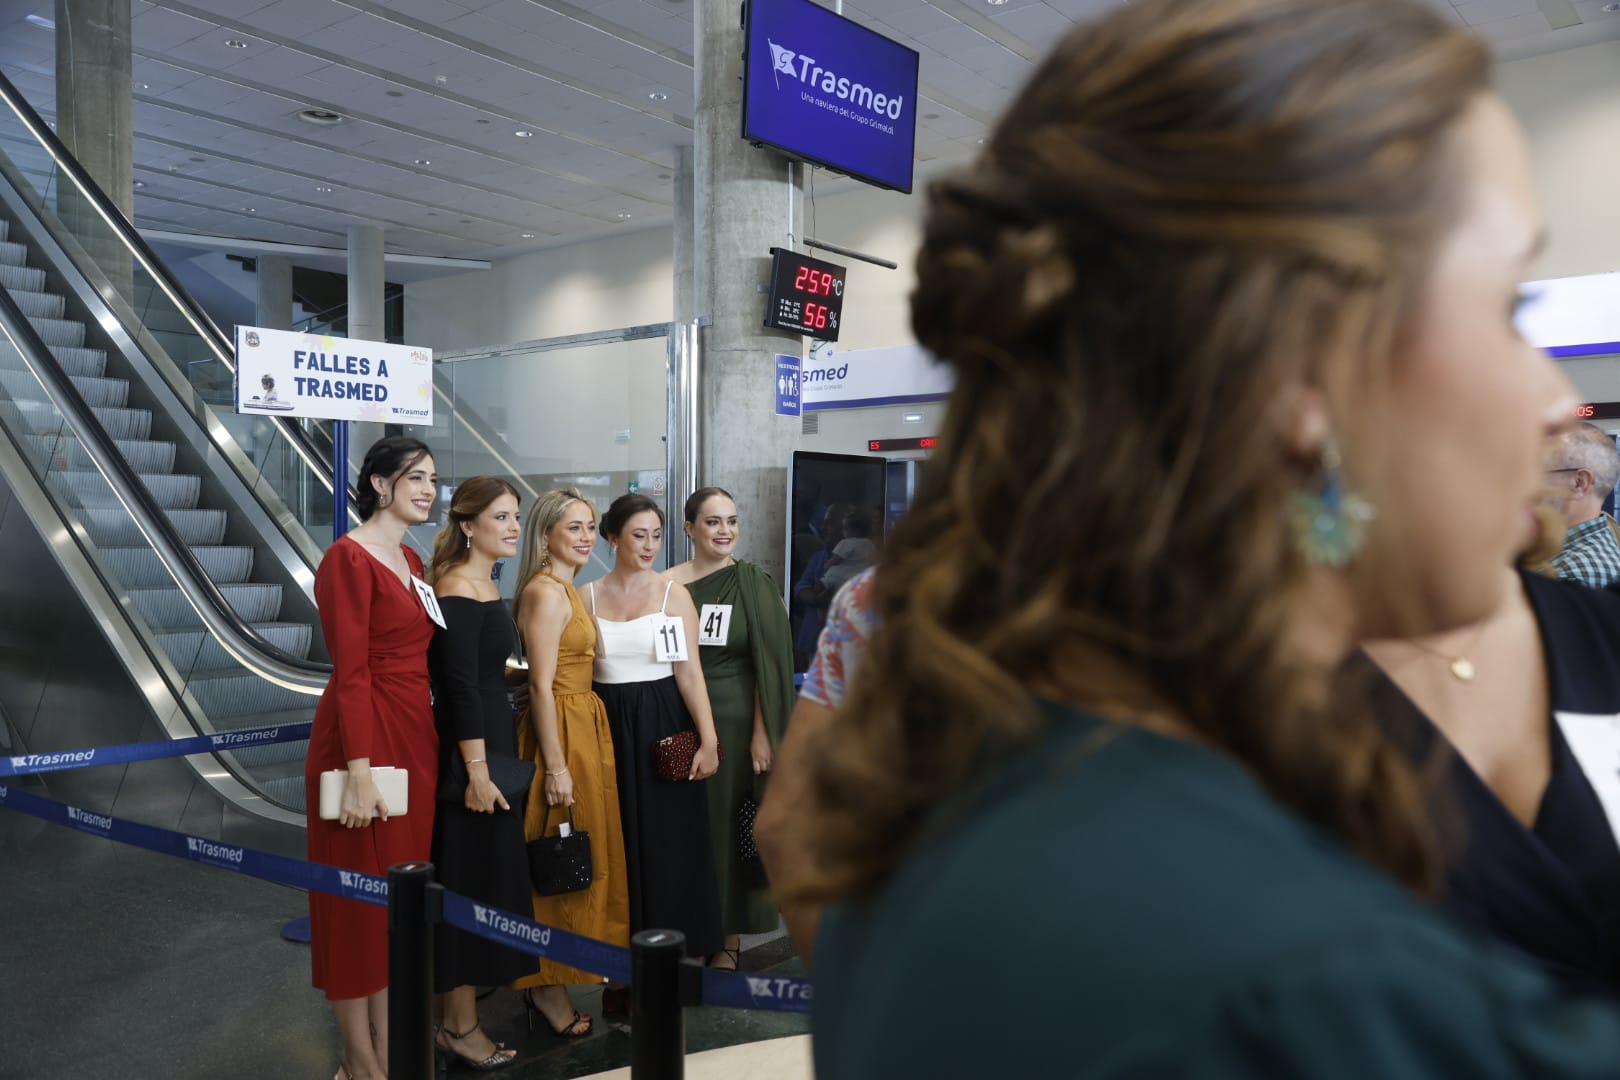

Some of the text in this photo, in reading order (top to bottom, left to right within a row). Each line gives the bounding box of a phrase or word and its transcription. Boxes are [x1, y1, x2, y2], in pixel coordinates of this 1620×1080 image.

[798, 54, 903, 120] Trasmed
[801, 91, 894, 135] Una naviera del Grupo Grimaldi
[803, 302, 828, 328] 56
[294, 350, 389, 378] FALLES A
[802, 363, 848, 382] smed
[294, 377, 388, 402] TRASMED
[399, 408, 428, 416] Trasmed
[704, 611, 723, 638] 41
[660, 624, 679, 653] 11
[225, 728, 279, 744] Trasmed
[28, 748, 95, 767] Trasmed
[75, 808, 112, 830] Trasmed
[198, 839, 243, 863] Trasmed
[488, 909, 551, 946] Trasmed
